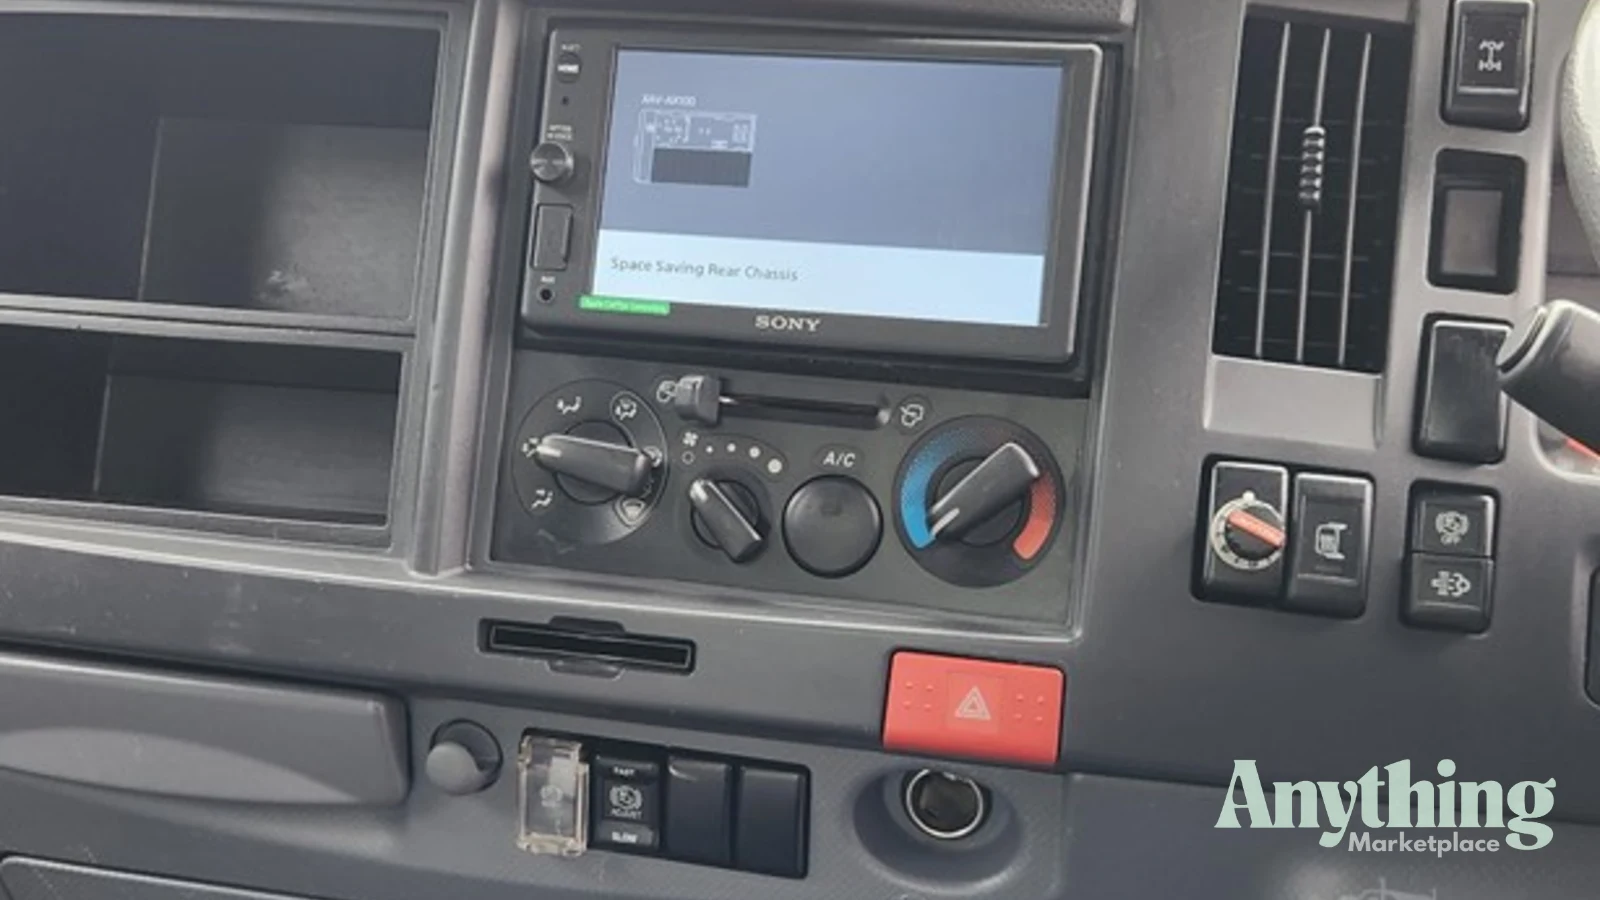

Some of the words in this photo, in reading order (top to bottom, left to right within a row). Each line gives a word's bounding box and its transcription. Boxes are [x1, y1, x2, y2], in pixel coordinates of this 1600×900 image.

[610, 256, 653, 273] Space
[655, 260, 705, 278] Saving
[707, 262, 742, 278] Rear
[744, 265, 799, 282] Chassis
[754, 314, 822, 333] SONY
[822, 450, 856, 469] A/C
